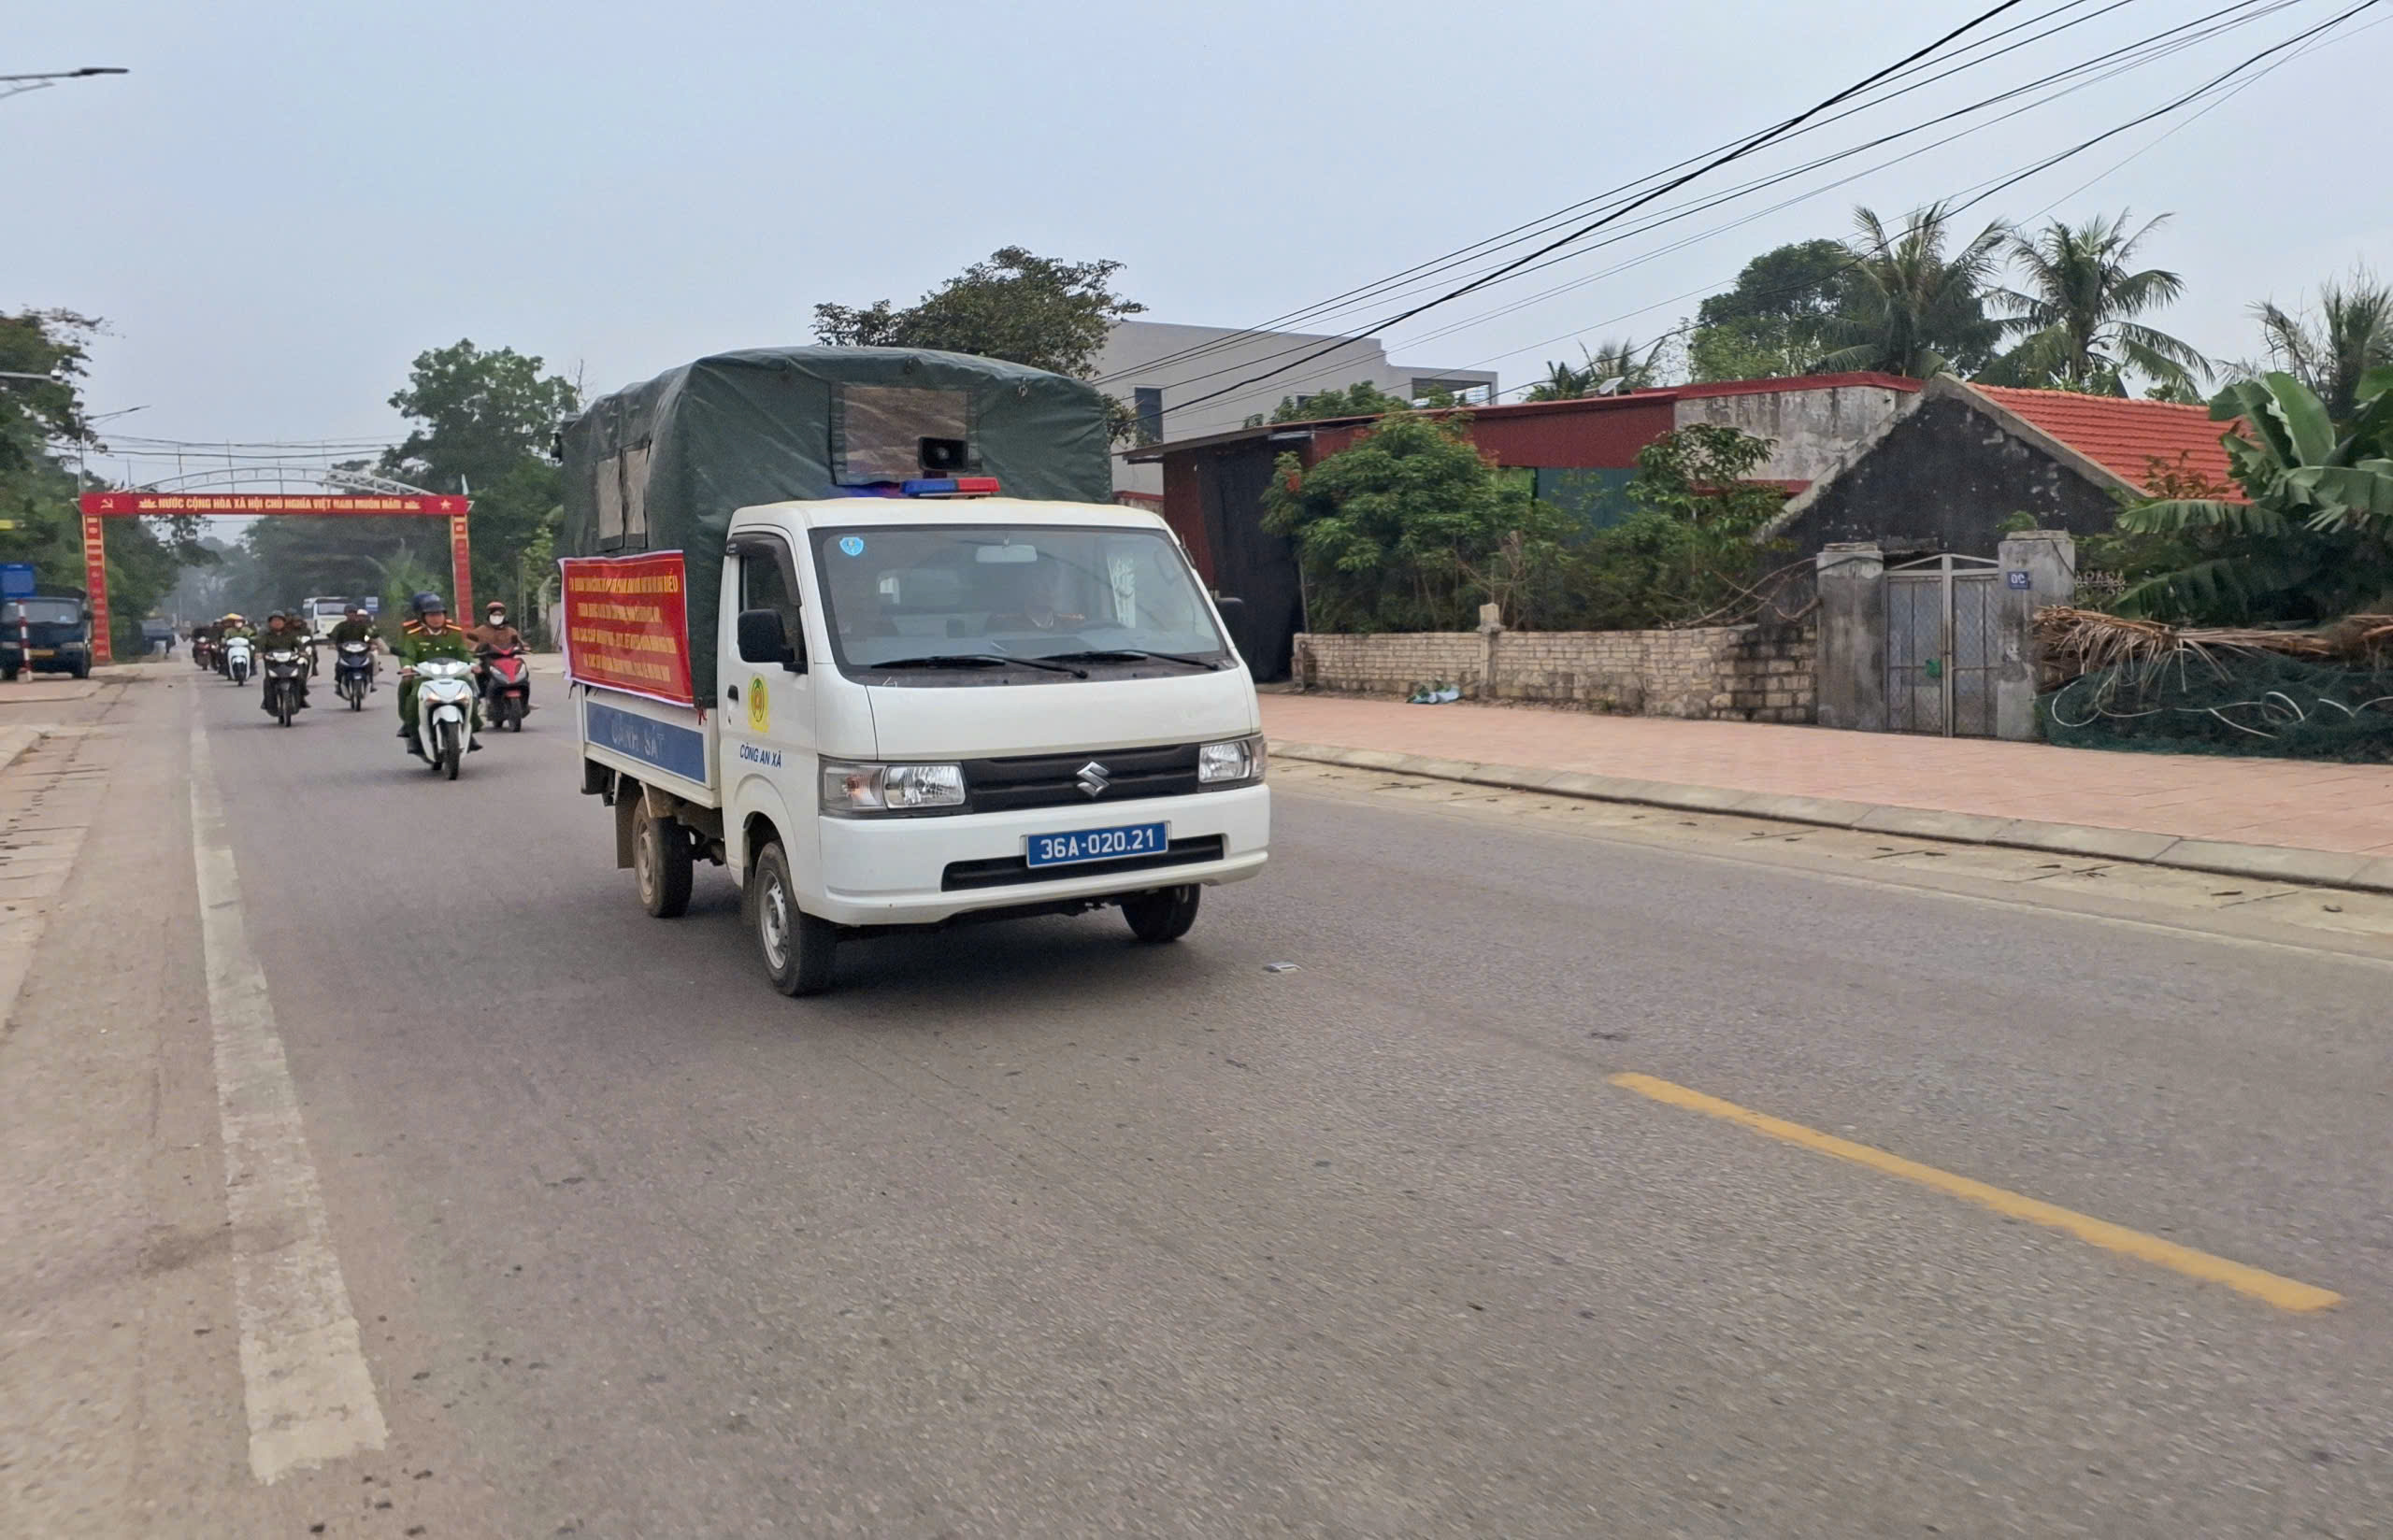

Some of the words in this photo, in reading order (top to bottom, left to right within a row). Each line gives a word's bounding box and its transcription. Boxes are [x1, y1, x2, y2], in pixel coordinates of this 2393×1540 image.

[186, 496, 211, 511] CỘNG
[248, 496, 264, 511] HỘI
[265, 496, 283, 509] CHỦ
[284, 496, 312, 509] NGHĨA
[312, 496, 332, 511] VIỆT
[759, 749, 771, 765] AN
[1039, 828, 1154, 860] 36A-020.21
